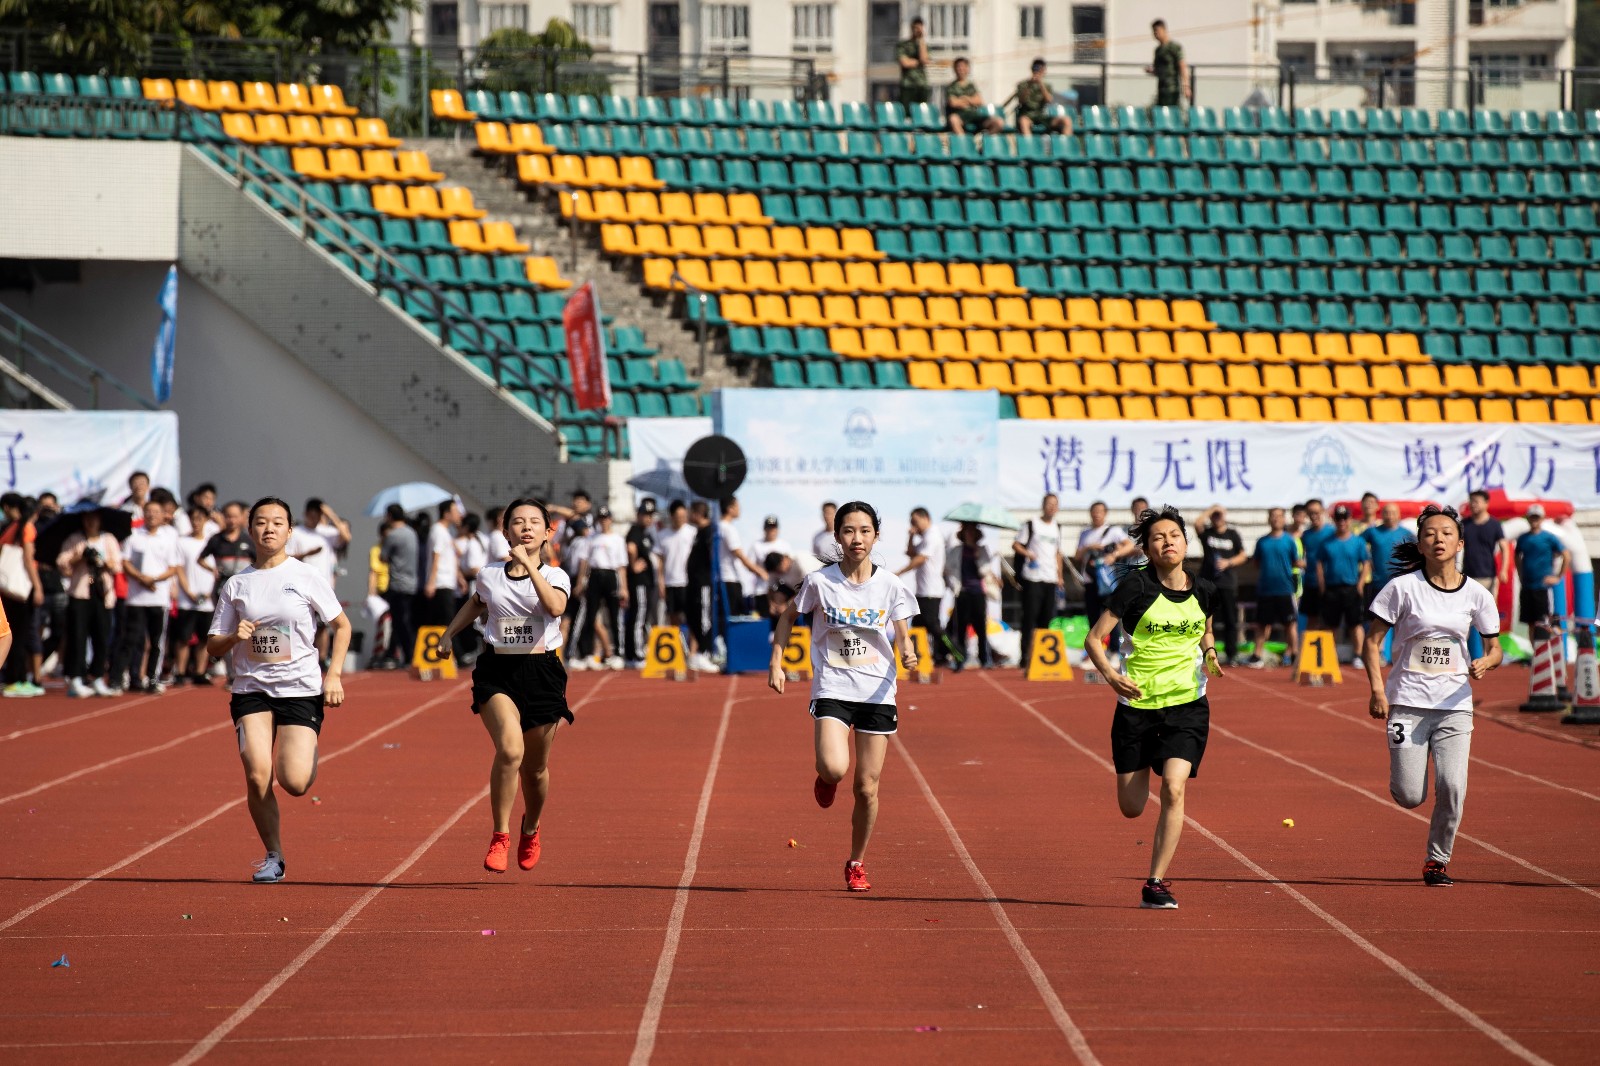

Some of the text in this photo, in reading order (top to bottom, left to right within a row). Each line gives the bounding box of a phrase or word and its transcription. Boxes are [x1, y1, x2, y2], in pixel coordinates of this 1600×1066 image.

[1040, 435, 1253, 492] 潜力无限
[252, 645, 280, 654] 10216
[423, 632, 442, 663] 8
[503, 636, 534, 644] 10719
[655, 632, 676, 664] 6
[784, 632, 804, 664] 5
[839, 646, 867, 657] 10717
[1039, 634, 1061, 666] 3
[1309, 637, 1323, 668] 1
[1420, 655, 1451, 665] 10718
[1392, 722, 1406, 745] 3
